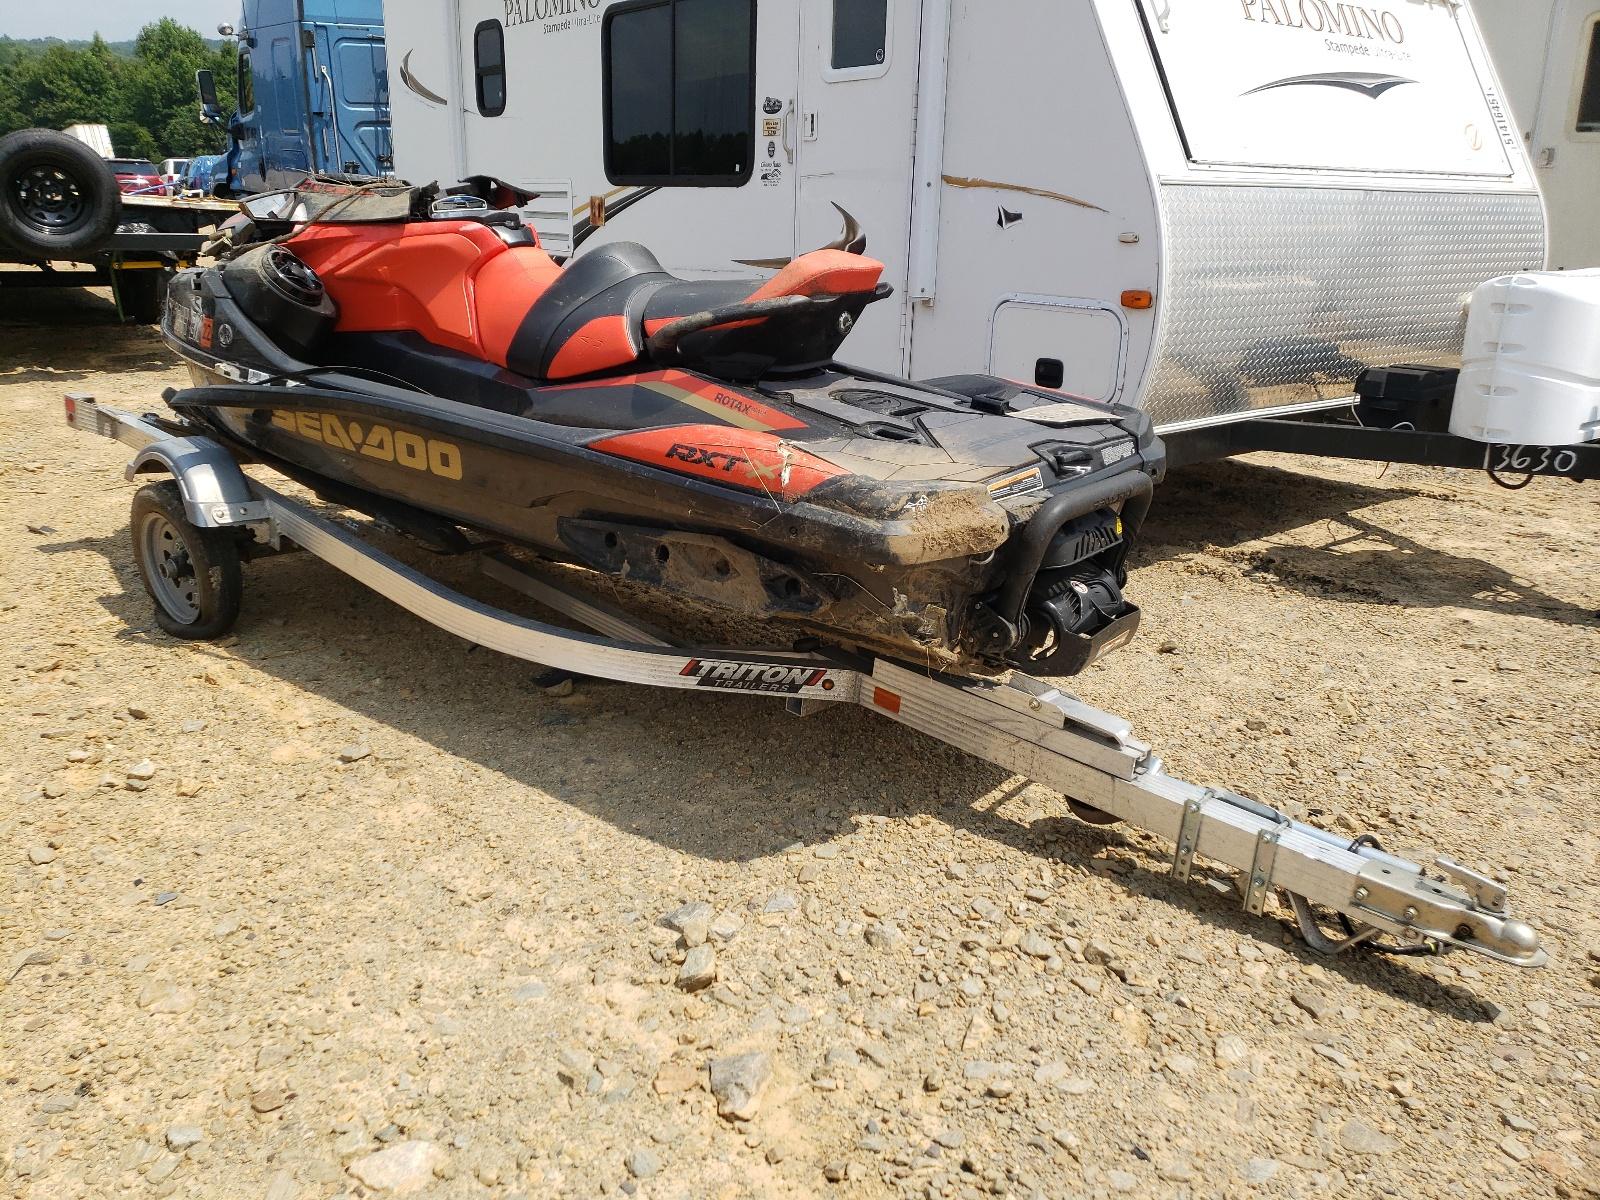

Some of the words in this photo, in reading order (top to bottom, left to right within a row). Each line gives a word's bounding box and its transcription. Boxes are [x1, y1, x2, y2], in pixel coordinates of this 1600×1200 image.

[714, 392, 752, 415] ROTAX
[697, 660, 814, 685] TRITON
[714, 678, 790, 692] TRAILERS
